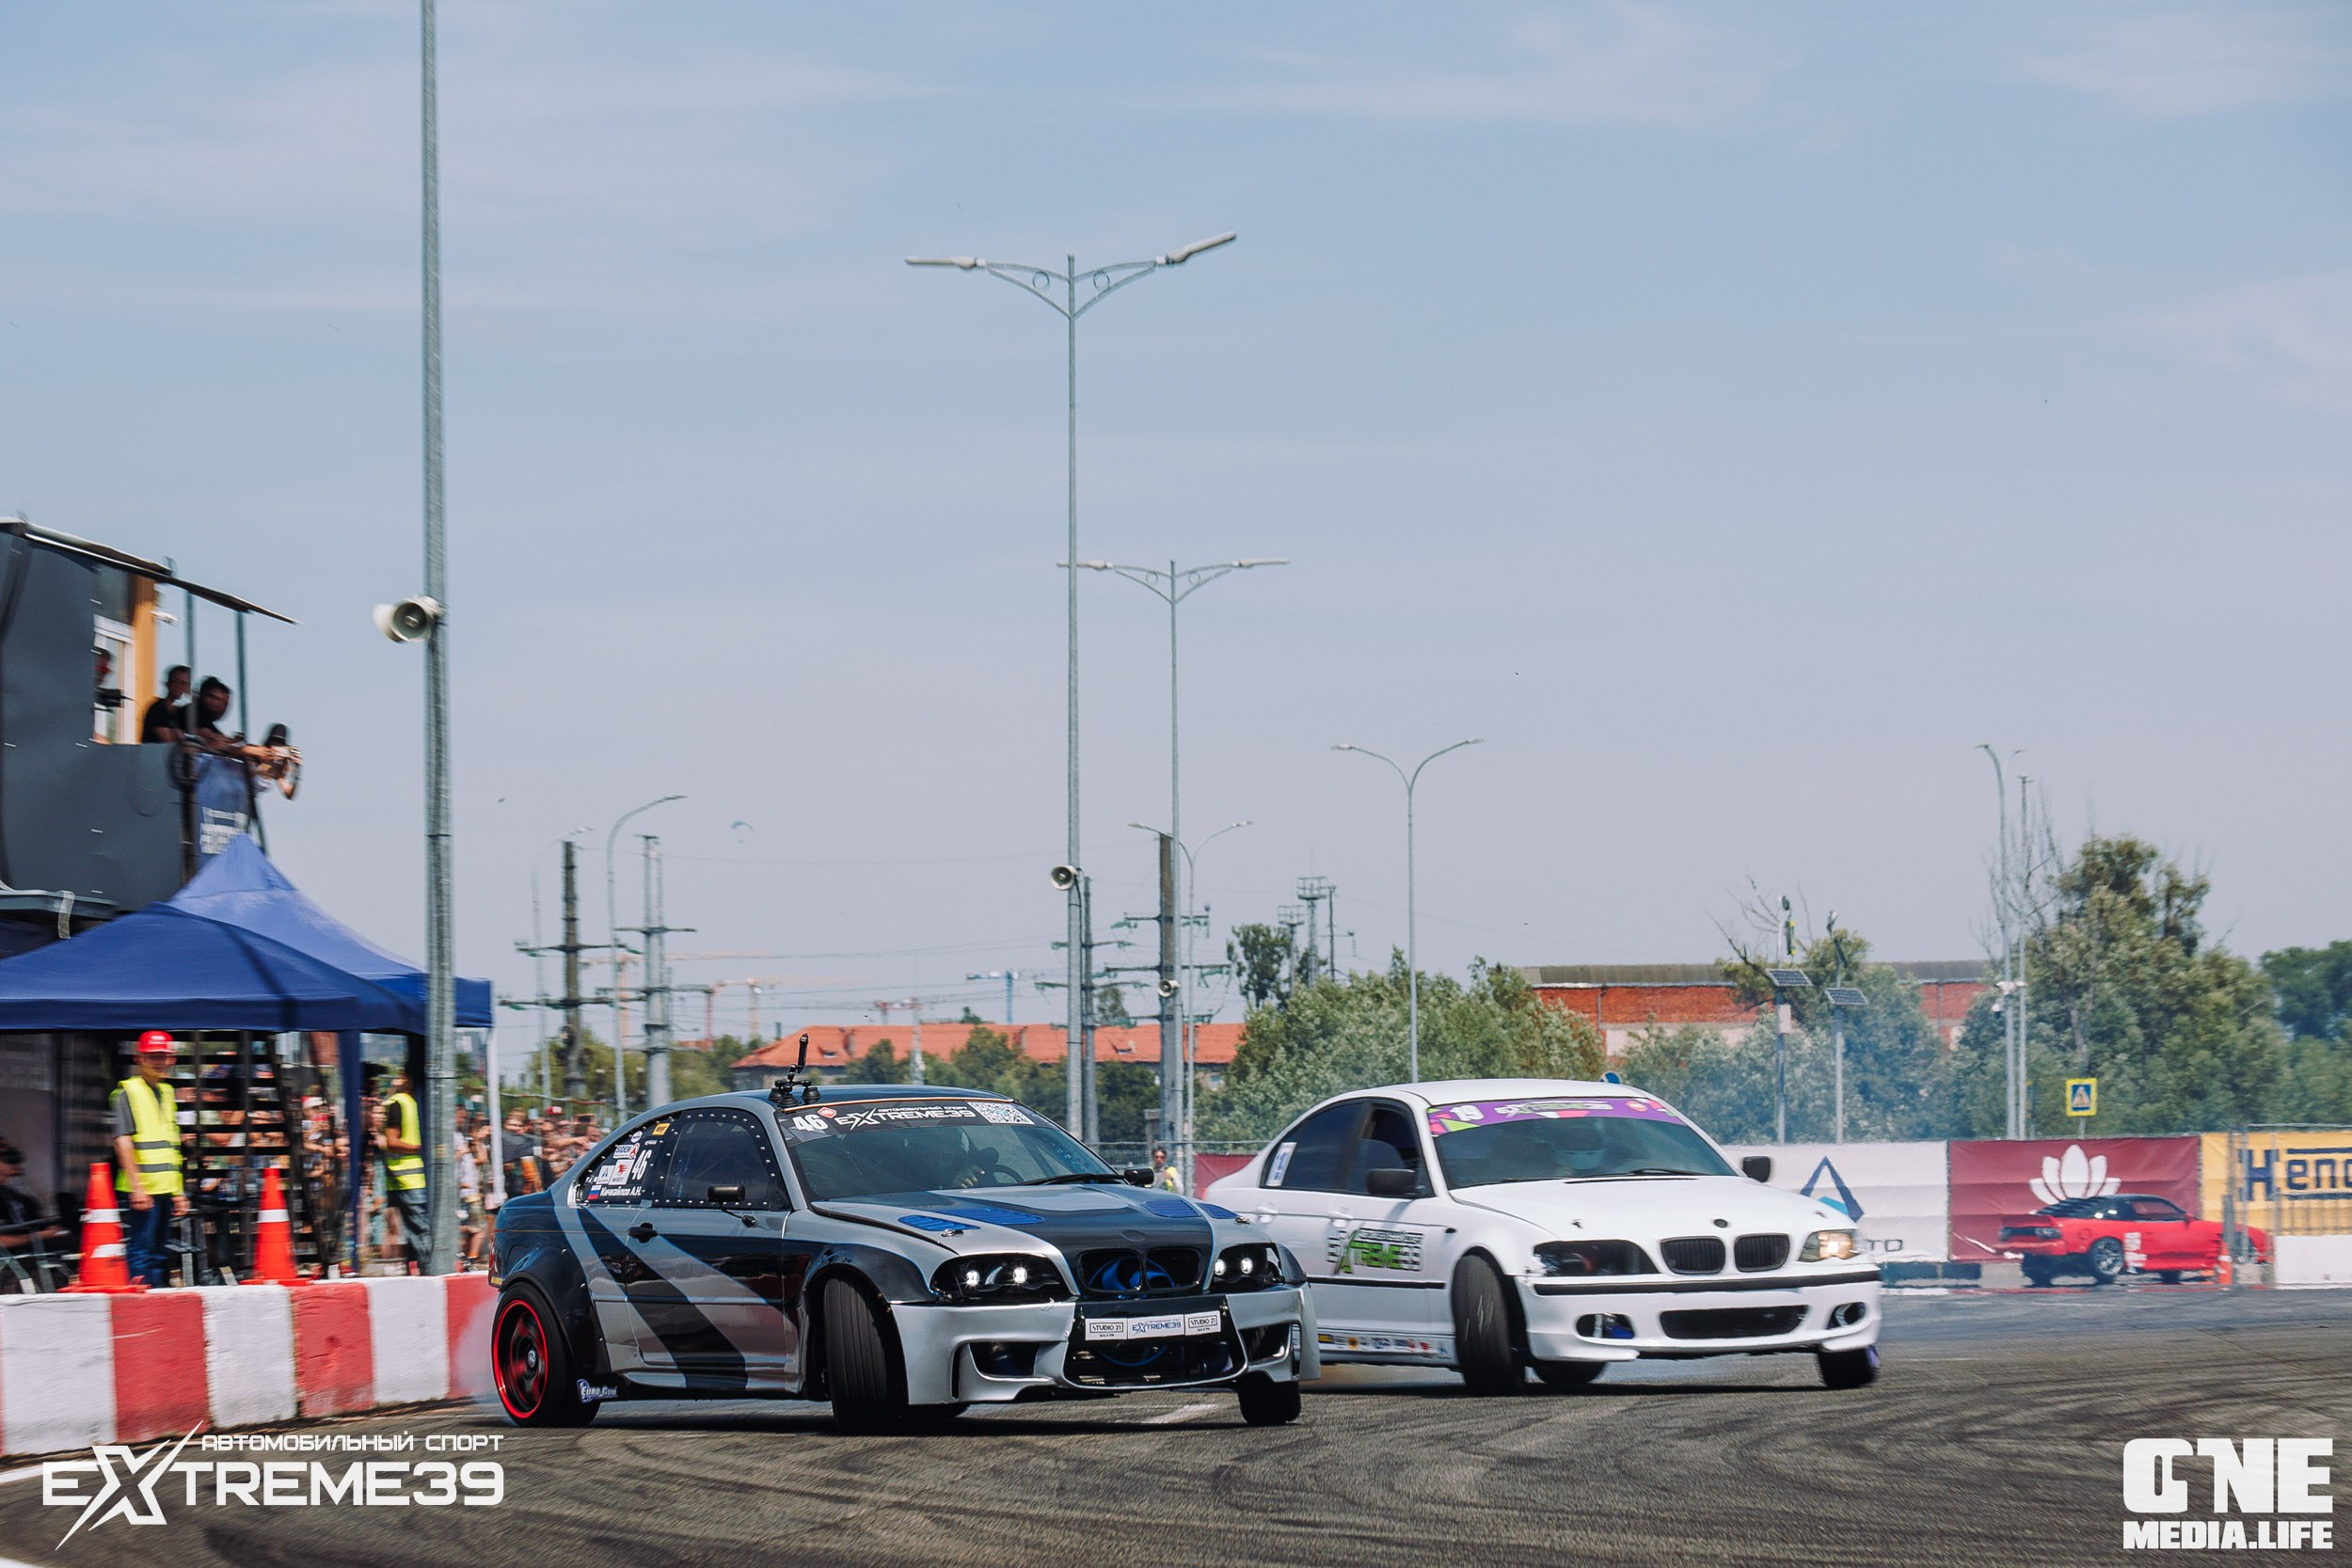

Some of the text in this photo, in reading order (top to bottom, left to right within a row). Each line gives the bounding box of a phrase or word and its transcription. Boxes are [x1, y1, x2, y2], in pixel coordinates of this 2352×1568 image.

[834, 1108, 977, 1130] EXTREME39
[1450, 1103, 1485, 1121] 19
[792, 1114, 829, 1132] 46
[631, 1149, 652, 1180] 46
[1132, 1320, 1182, 1334] EXTREME39
